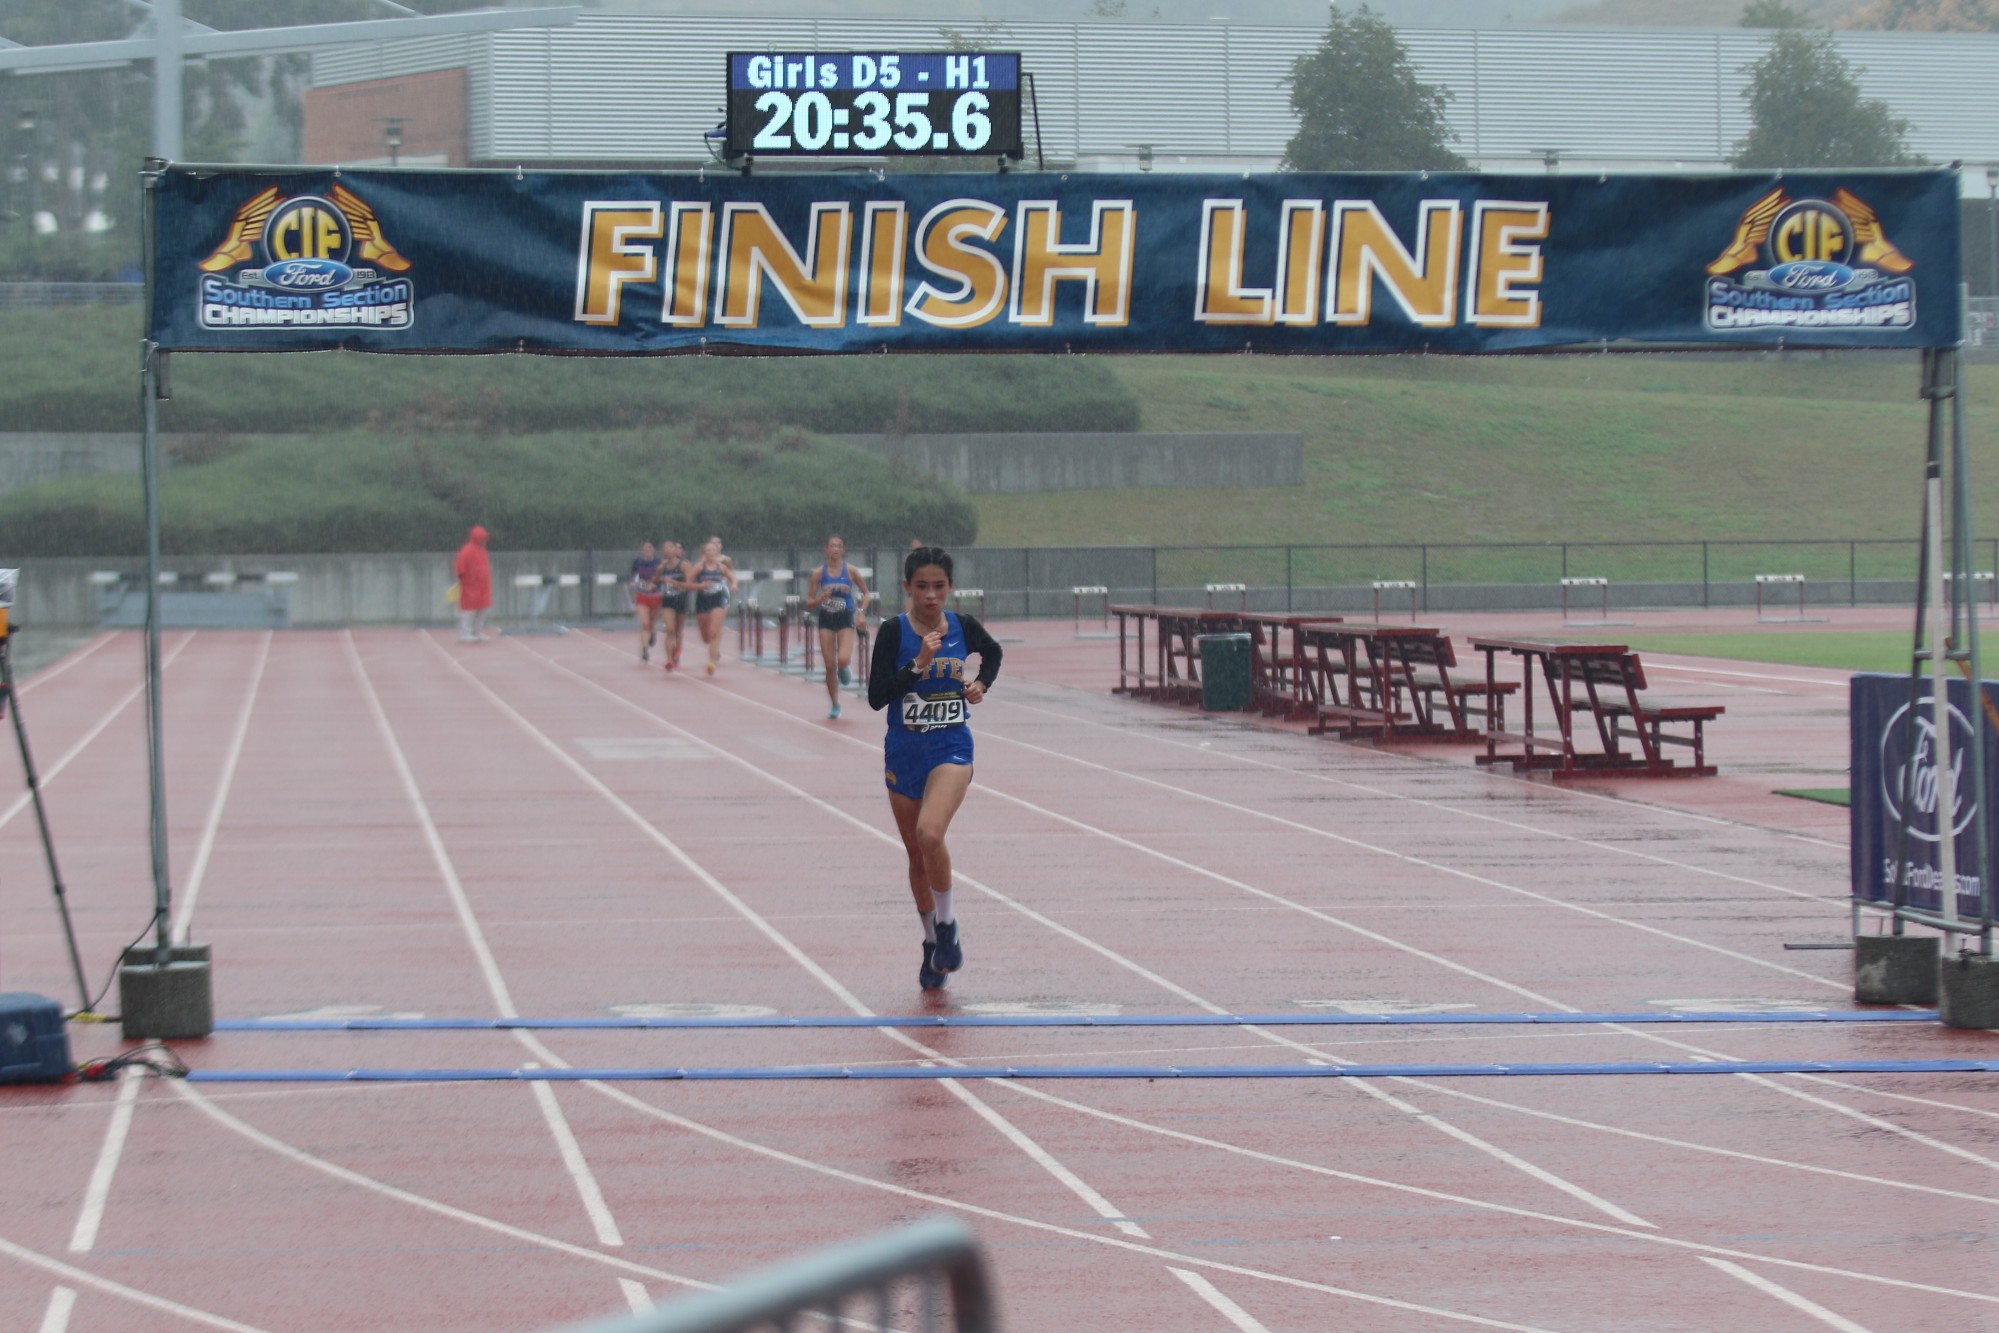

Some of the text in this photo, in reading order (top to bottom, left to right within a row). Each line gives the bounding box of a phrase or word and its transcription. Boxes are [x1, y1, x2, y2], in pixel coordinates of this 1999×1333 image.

[747, 56, 838, 88] Girls
[852, 56, 901, 88] D5
[946, 56, 989, 88] H1
[753, 91, 991, 150] 20:35.6
[275, 207, 342, 260] CIF
[1777, 210, 1844, 263] CIF
[280, 263, 336, 286] Ford
[574, 199, 1552, 328] FINISH LINE
[1784, 265, 1839, 288] Ford
[204, 280, 408, 309] Southern Section
[1710, 282, 1909, 309] Southern Section
[204, 303, 408, 325] CHAMPIONSHIPS
[1709, 303, 1911, 327] CHAMPIONSHIPS
[905, 701, 960, 723] 4409
